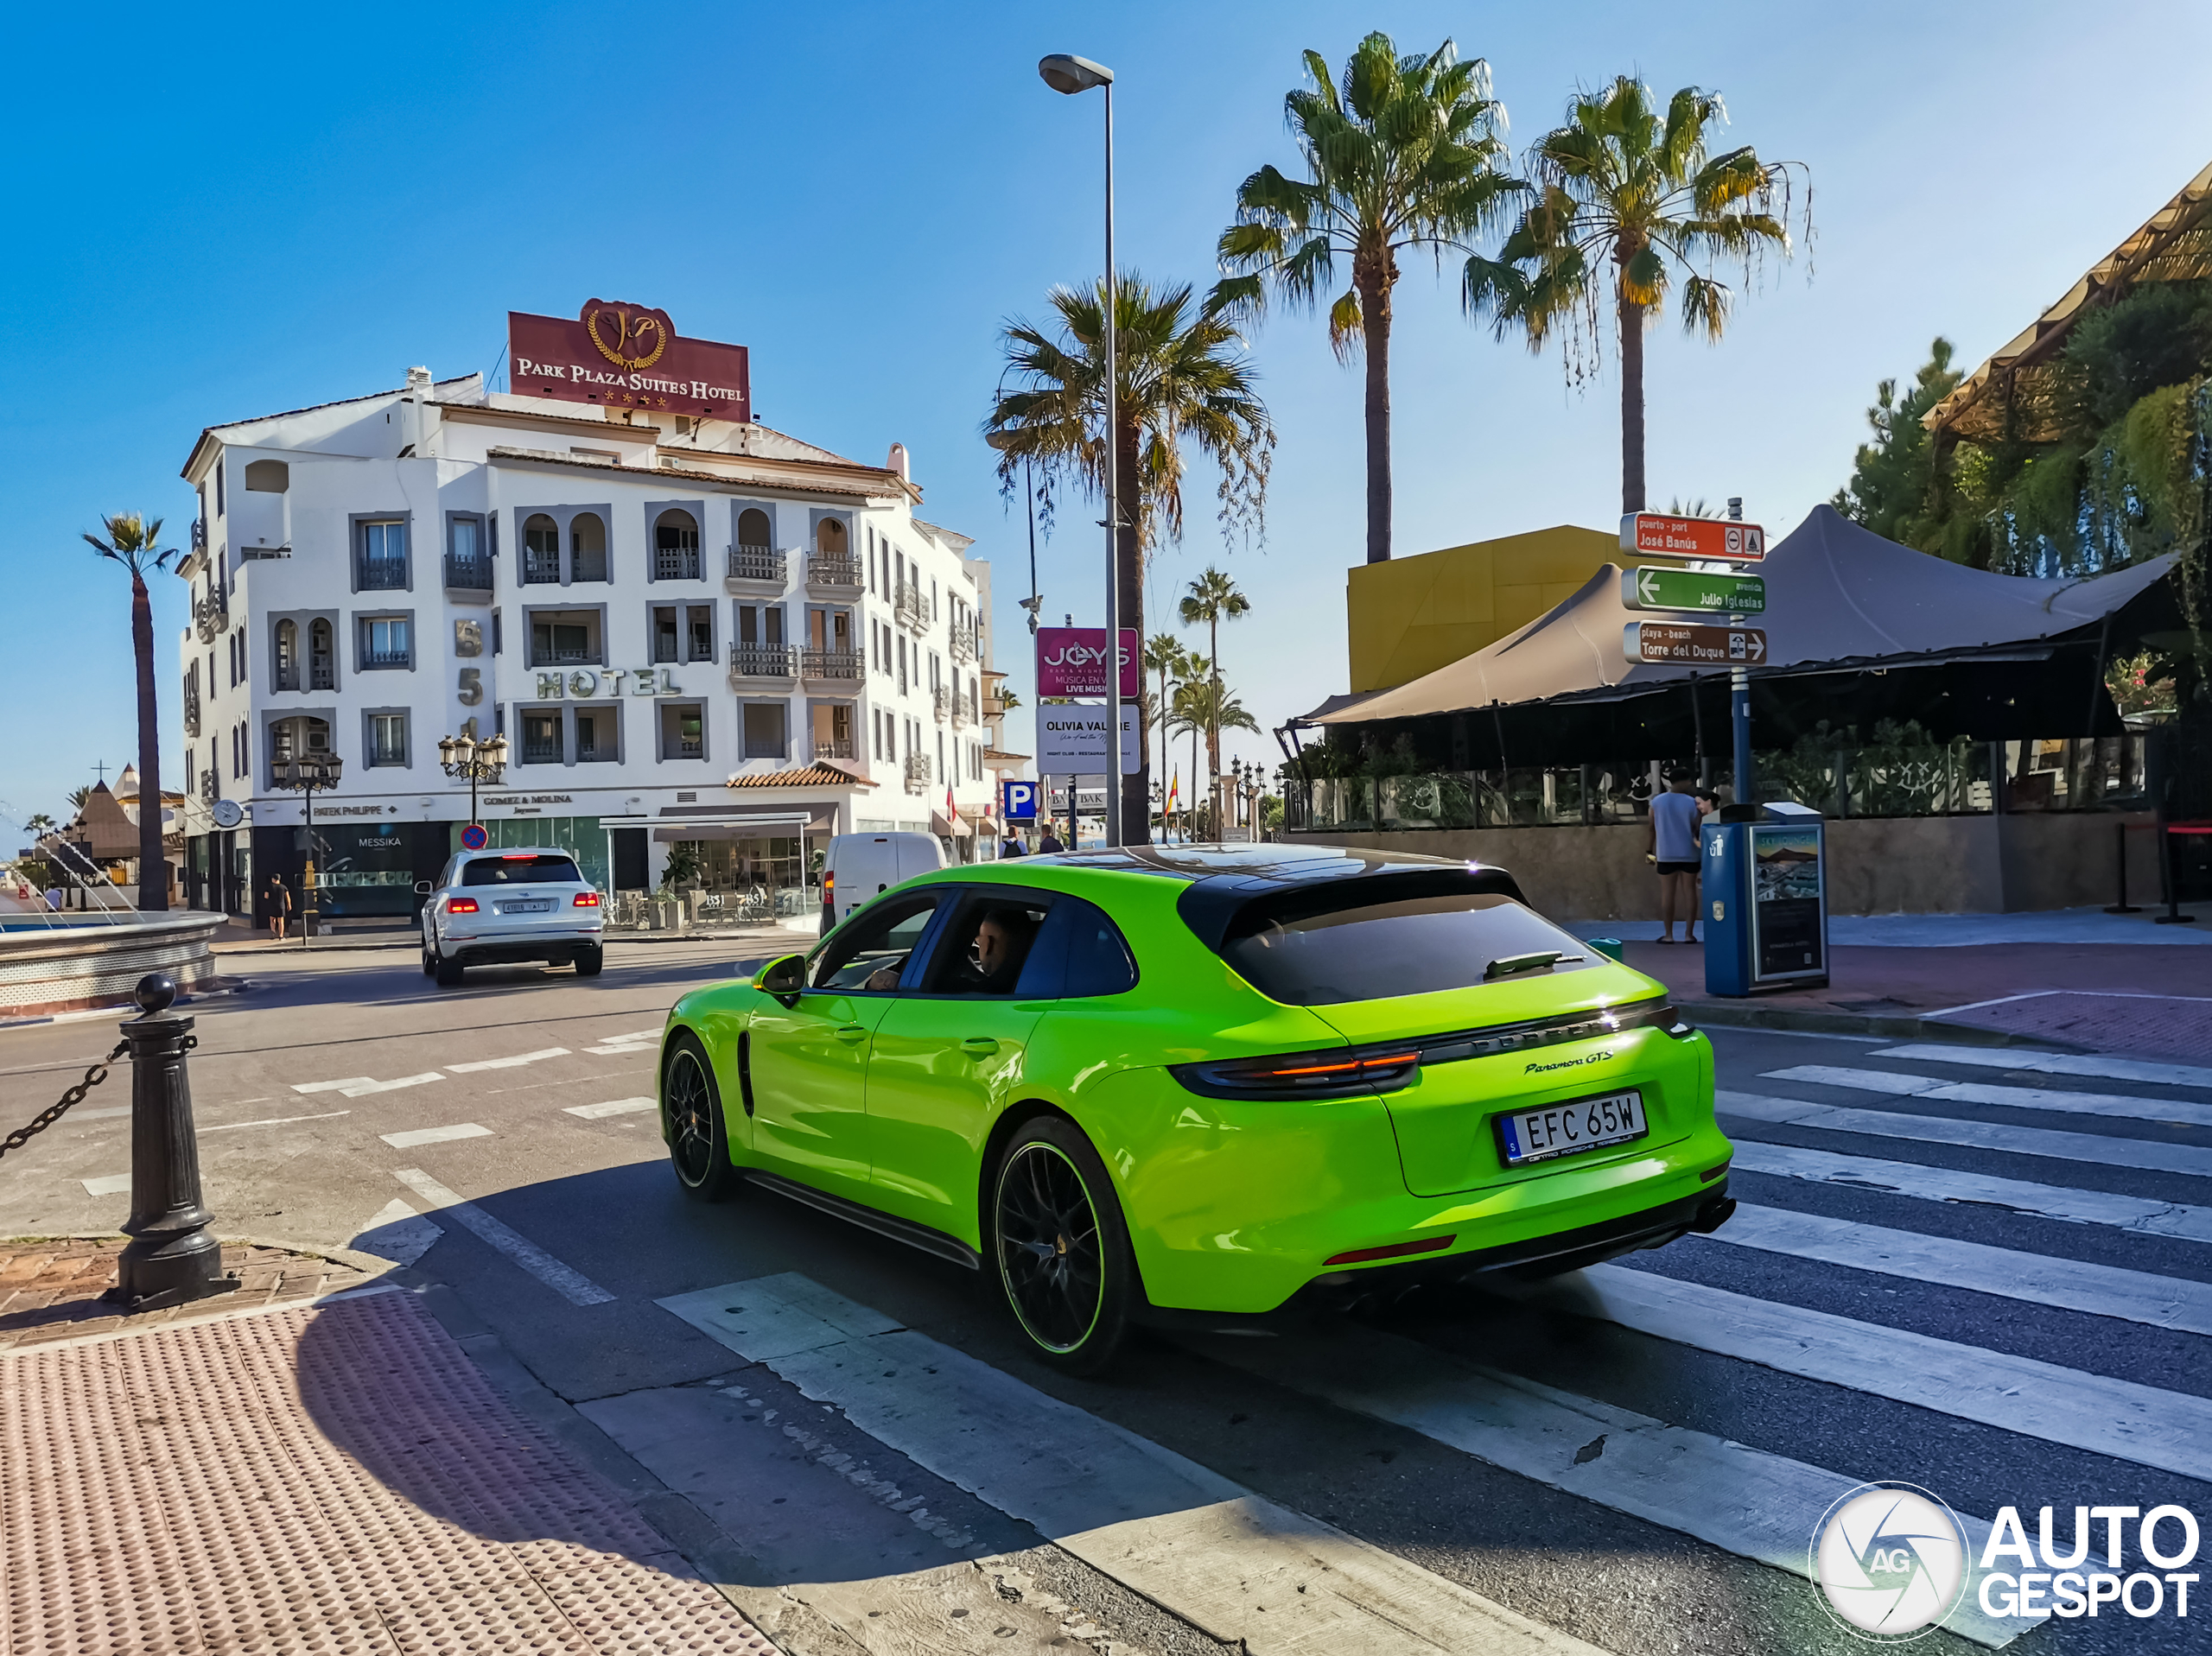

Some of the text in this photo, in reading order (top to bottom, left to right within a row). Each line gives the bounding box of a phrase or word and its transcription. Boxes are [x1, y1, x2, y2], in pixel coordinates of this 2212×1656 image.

[517, 358, 745, 402] PARK PLAZA SUITES HOTEL
[1639, 520, 1664, 530] puerto
[1671, 522, 1688, 532] port
[1640, 533, 1697, 549] José Banús
[1736, 582, 1763, 592] avenida
[1700, 592, 1763, 609] Julio Iglesias
[1641, 628, 1662, 639] playa
[1669, 630, 1691, 639] beach
[1044, 646, 1130, 667] JOYS
[1642, 642, 1725, 660] Torre del Duque
[537, 669, 682, 700] HOTEL
[1055, 675, 1087, 684] MÚSICA
[1046, 721, 1084, 731] OLIVIA
[484, 796, 520, 805] GOMEZ
[531, 795, 572, 804] MOLINA
[1009, 784, 1032, 813] P
[1052, 794, 1103, 805] BA BAK
[313, 805, 383, 816] PATEK PHILIPPE
[359, 837, 402, 847] MESSIKA
[1586, 1049, 1614, 1064] GTS
[1525, 1097, 1635, 1150] EFC 65W
[1510, 1142, 1516, 1152] S
[1560, 1143, 1595, 1155] PORSCHE
